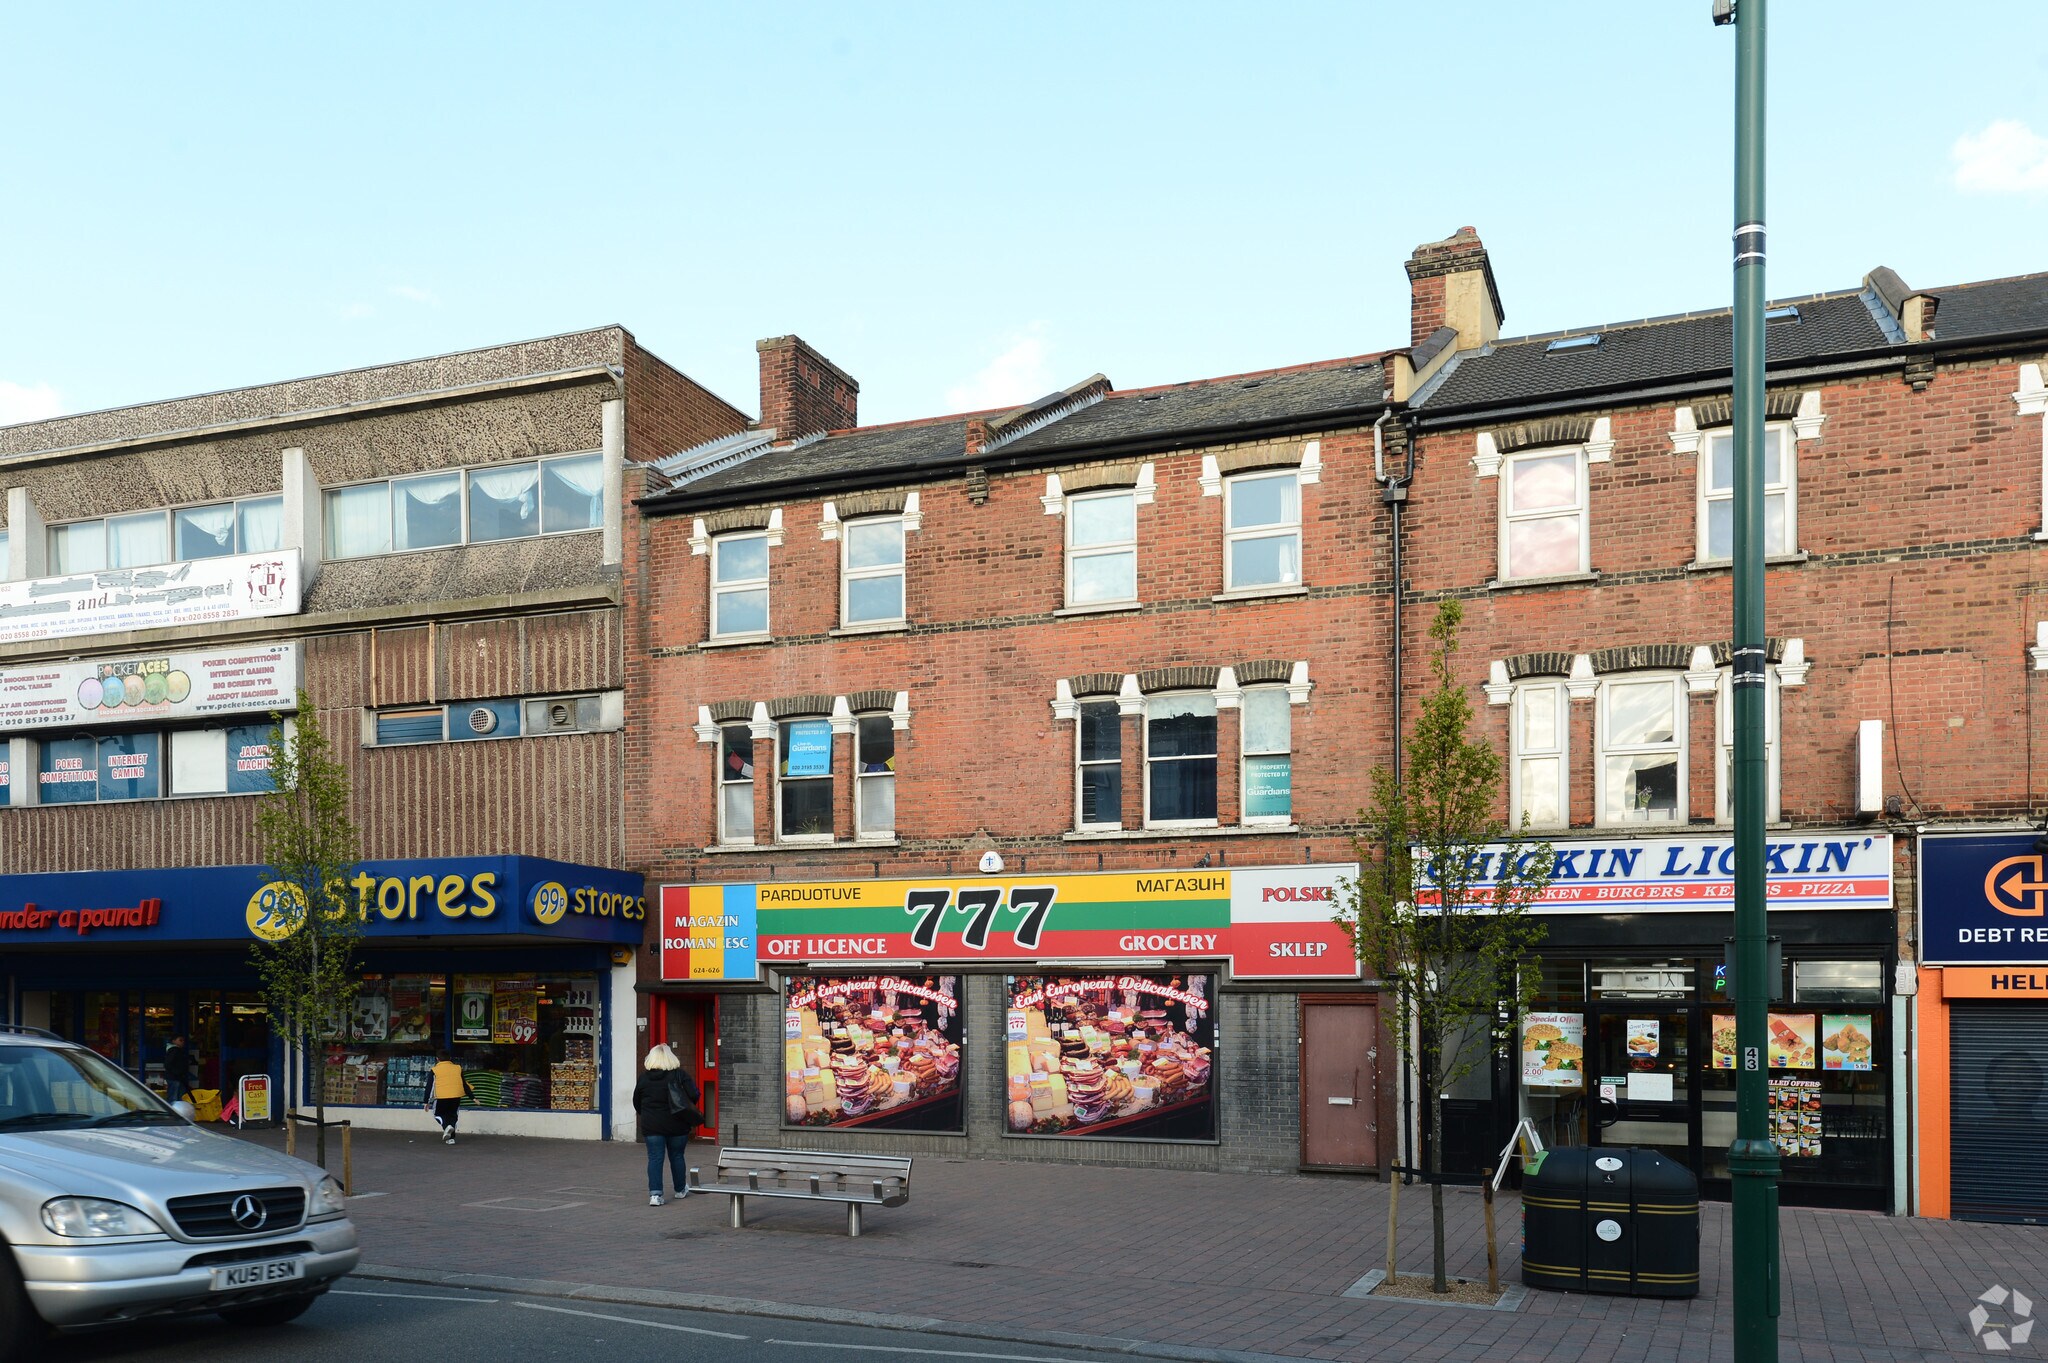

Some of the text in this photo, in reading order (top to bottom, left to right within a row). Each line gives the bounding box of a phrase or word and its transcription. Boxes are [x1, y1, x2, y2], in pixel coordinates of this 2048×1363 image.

[78, 593, 108, 611] and
[32, 629, 48, 637] 0239
[222, 609, 239, 618] 2831
[202, 654, 281, 667] POKER COMPETITIONS
[4, 676, 35, 684] SNOOKER
[36, 673, 60, 681] TABLES
[210, 666, 275, 678] INTERNET GAMING
[227, 680, 255, 688] SCREEN
[207, 689, 279, 701] JACKPOT MACHINES
[23, 699, 67, 707] CONDITIONED
[195, 698, 291, 711] www.pocket-aces.co.uk
[25, 716, 49, 724] 8539
[52, 714, 75, 722] 3437
[792, 744, 827, 752] Guardians
[55, 758, 82, 769] POKER
[108, 754, 148, 767] INTERNET
[40, 770, 98, 784] COMPETITIONS
[111, 767, 145, 779] GAMING
[1246, 787, 1290, 796] Guardians
[324, 870, 496, 921] stores
[761, 887, 861, 902] PARDUOTUVE
[1262, 886, 1333, 903] POLSKI
[1596, 886, 1685, 899] BURGERS
[1799, 883, 1856, 895] PIZZA
[539, 886, 646, 920] 99p stores
[0, 903, 58, 929] nder
[59, 909, 78, 928] a
[675, 915, 739, 927] MAGAZIN
[904, 884, 1058, 952] 777
[1958, 928, 2015, 943] DEBT
[767, 938, 887, 955] OFF LICENCE
[1119, 934, 1217, 951] GROCERY
[1269, 942, 1328, 957] SKLEP
[1991, 975, 2048, 990] HEL
[790, 977, 958, 1009] East European Delicatessen
[1015, 976, 1209, 1010] East European Delicatessen
[1009, 1020, 1025, 1029] 777
[1529, 1015, 1558, 1024] Special
[1790, 1080, 1820, 1088] OFFERS
[248, 1091, 264, 1099] Cash
[267, 1260, 297, 1280] ESN
